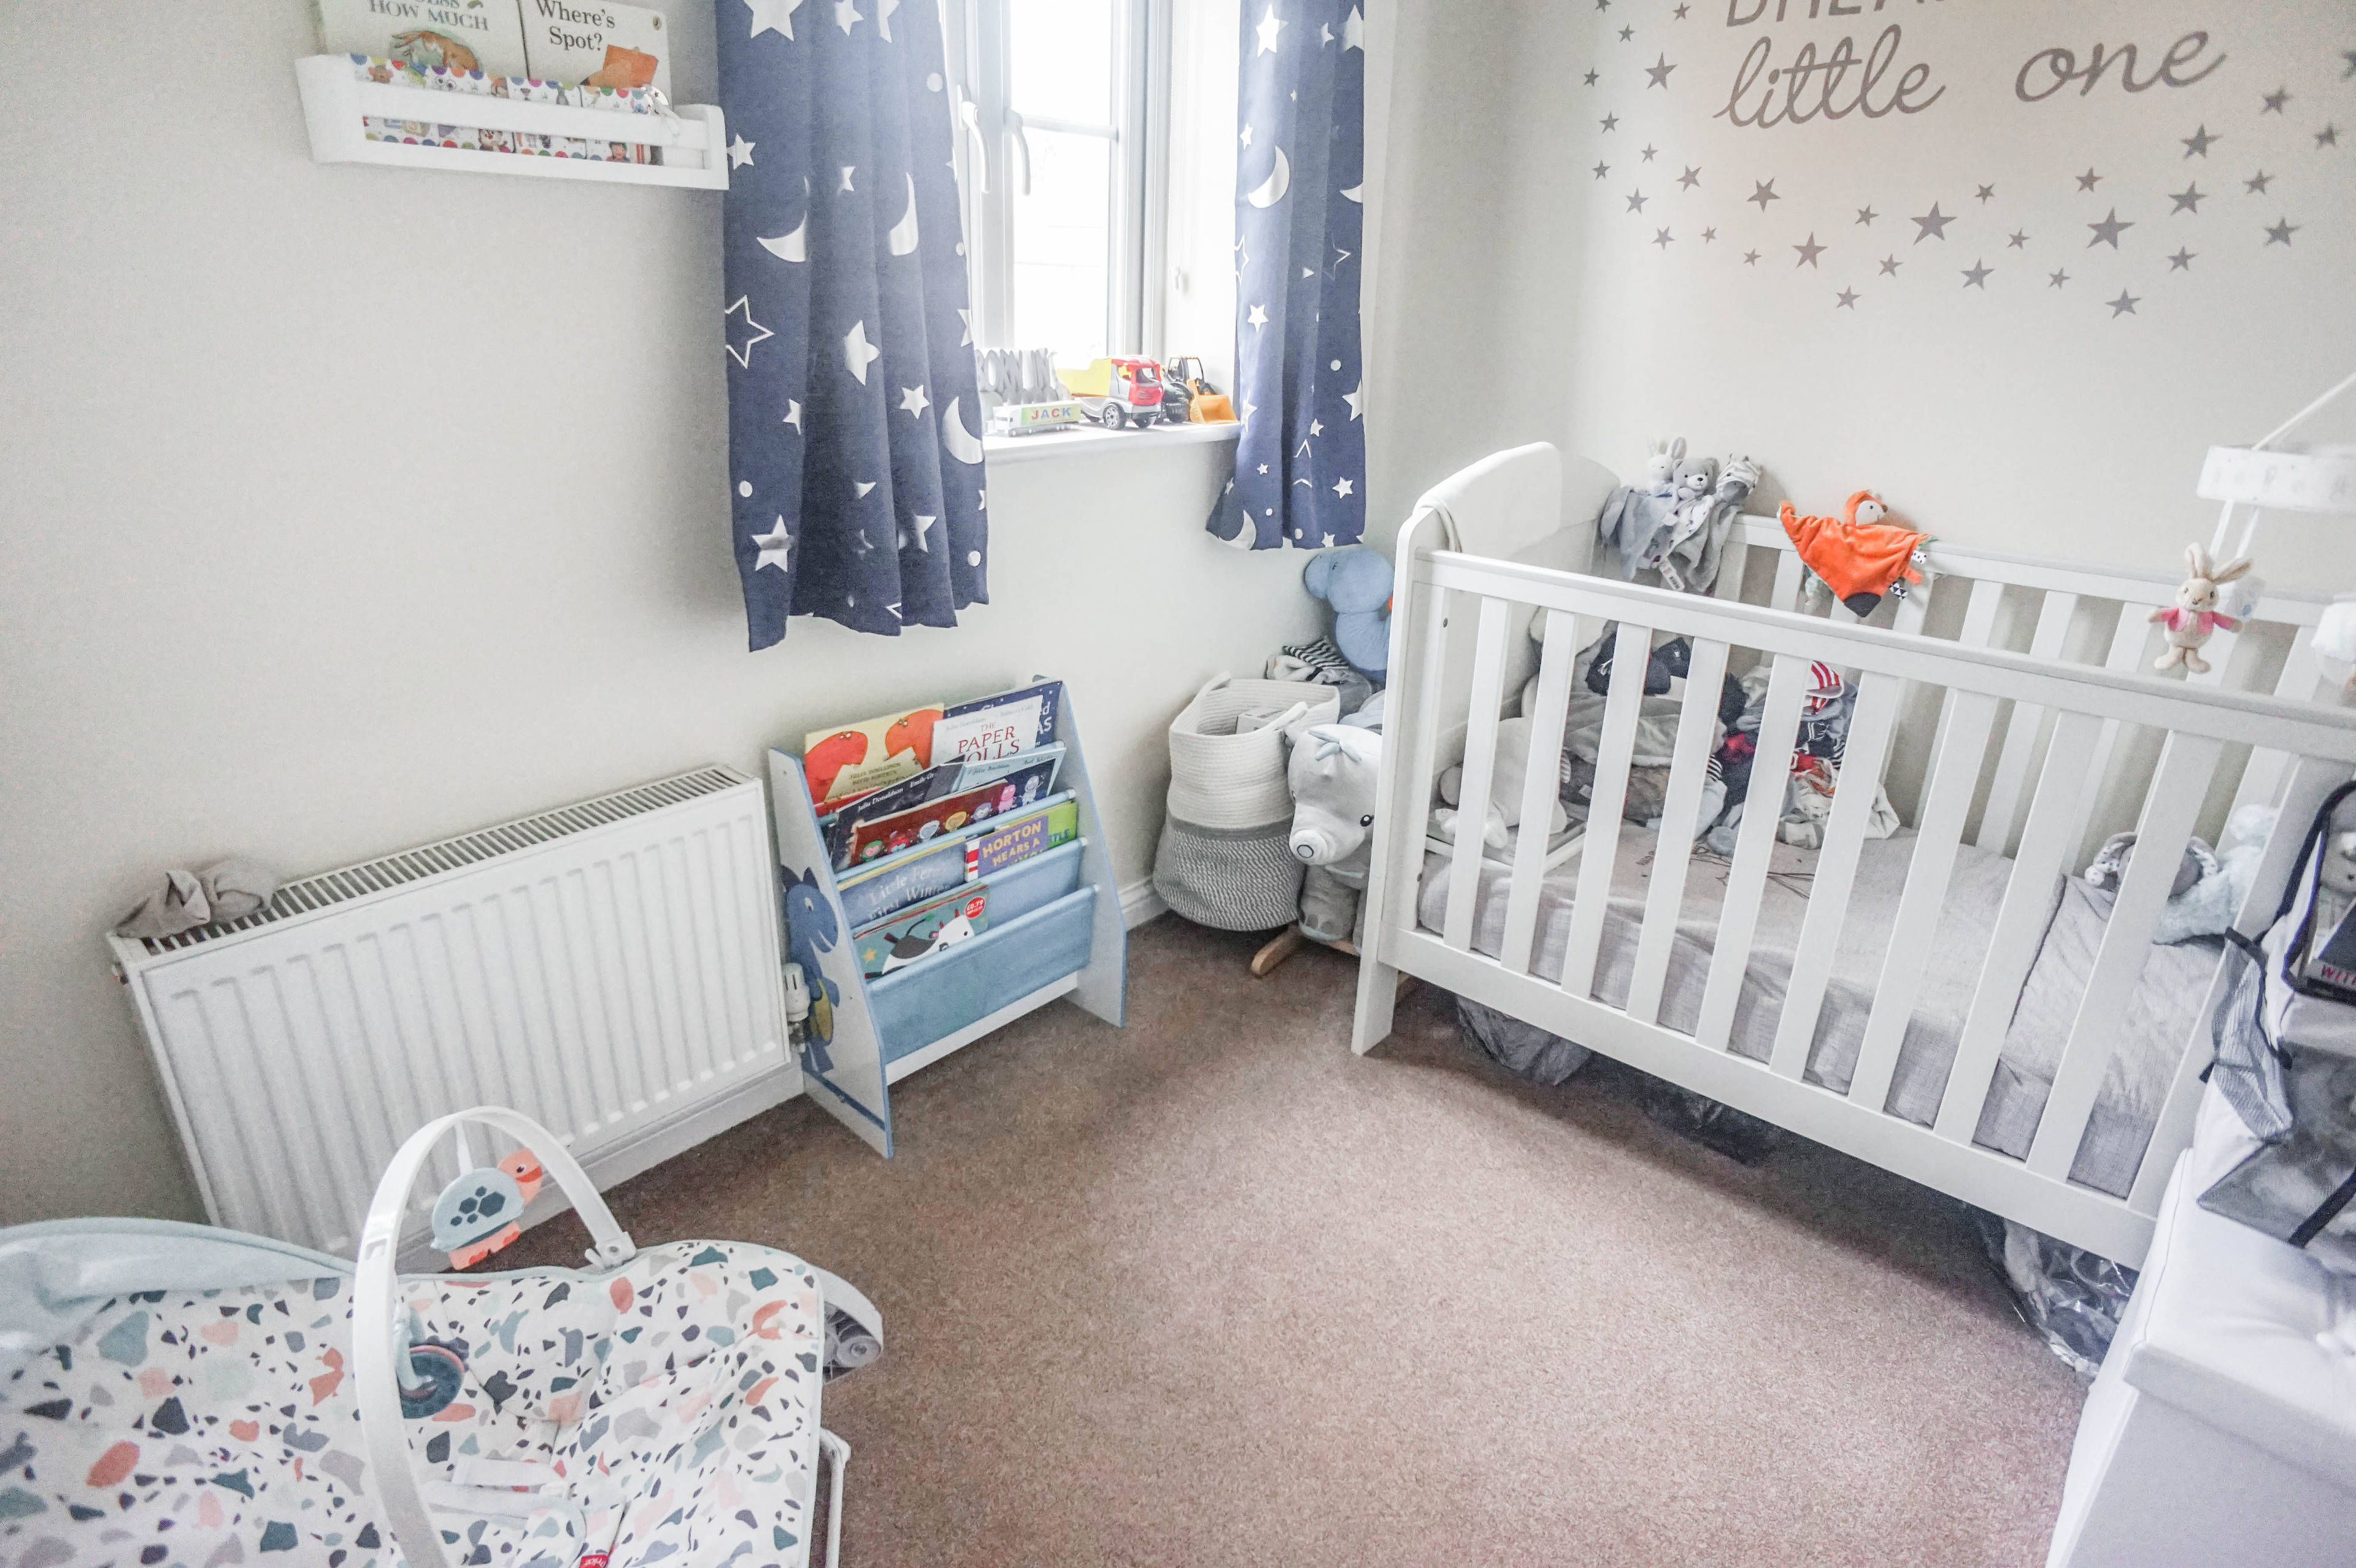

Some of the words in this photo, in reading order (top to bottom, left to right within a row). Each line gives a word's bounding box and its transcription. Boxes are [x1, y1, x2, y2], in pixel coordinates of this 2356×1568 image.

[369, 0, 420, 17] HOW
[428, 9, 489, 31] MUCH
[535, 0, 615, 29] Where's
[549, 26, 602, 51] Spot?
[1712, 24, 1947, 129] little
[2014, 30, 2228, 103] one
[1031, 407, 1071, 420] JACK
[958, 726, 1015, 754] PAPER
[982, 721, 997, 732] THE
[982, 820, 1042, 858] HORTON
[992, 841, 1030, 867] HEARS
[1033, 837, 1041, 848] A
[869, 874, 907, 905] Little
